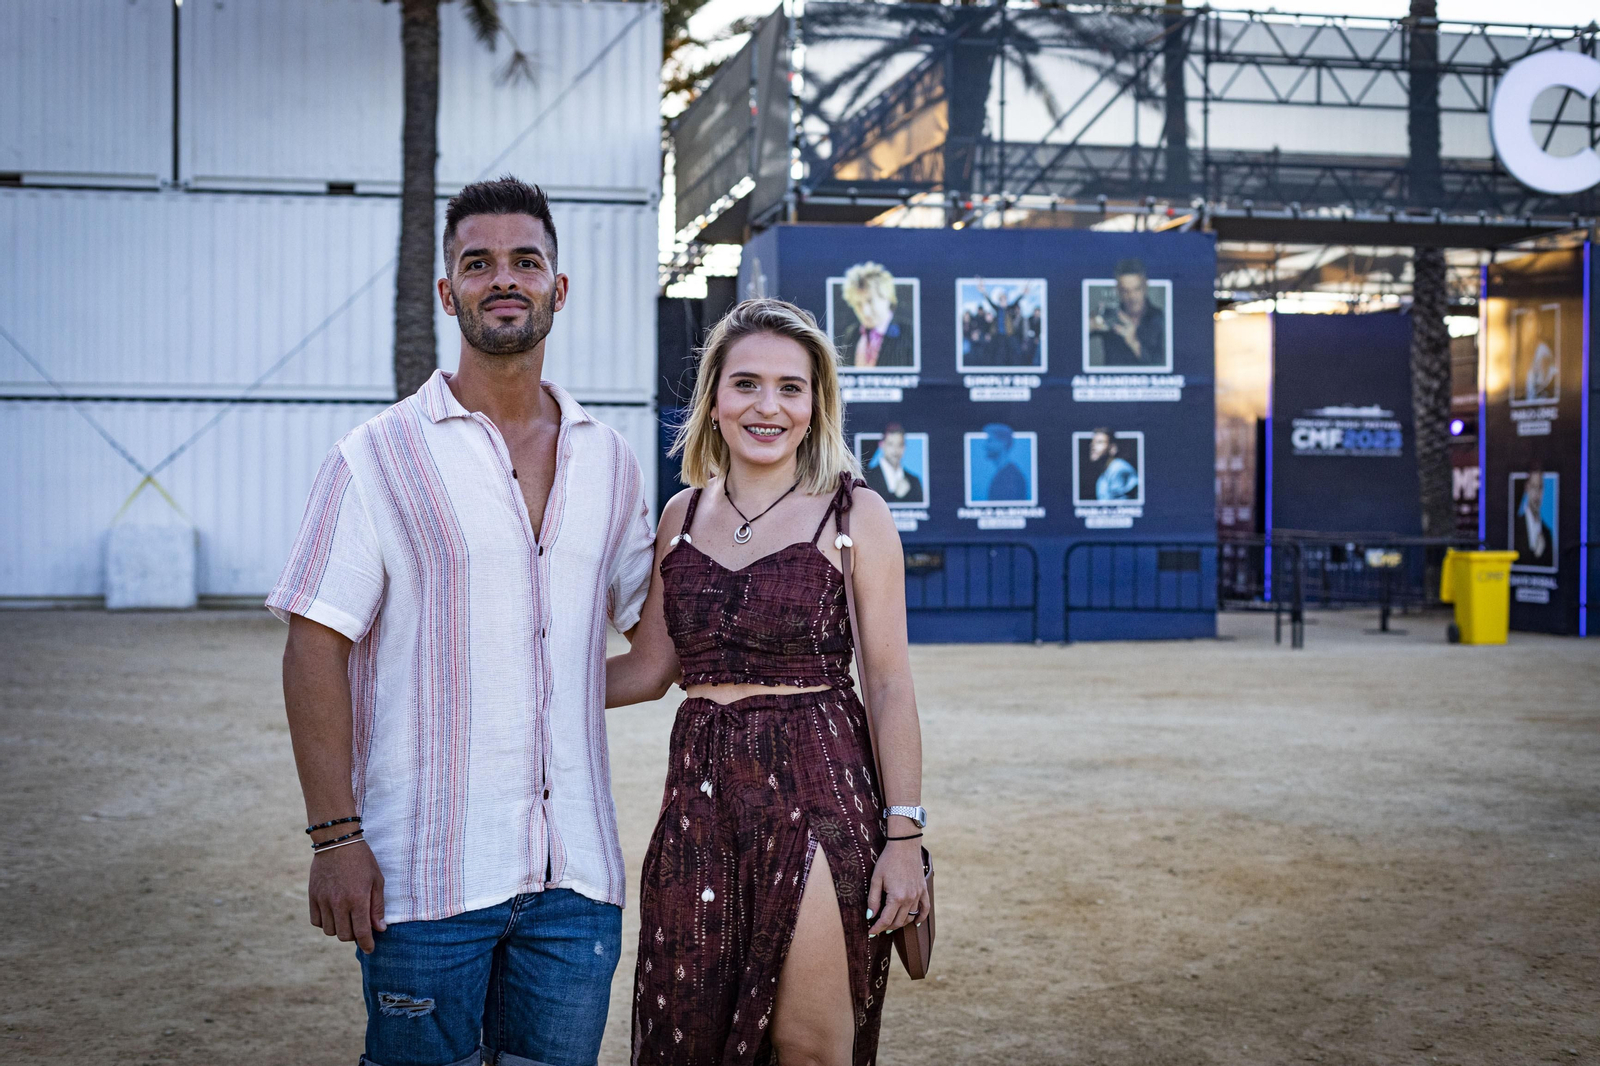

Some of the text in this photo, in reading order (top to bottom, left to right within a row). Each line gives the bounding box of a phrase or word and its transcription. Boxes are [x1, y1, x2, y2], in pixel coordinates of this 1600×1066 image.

[858, 375, 920, 388] STEWART
[963, 375, 1041, 388] SIMPLY RED
[1071, 375, 1185, 388] ALEJANDRO SANZ
